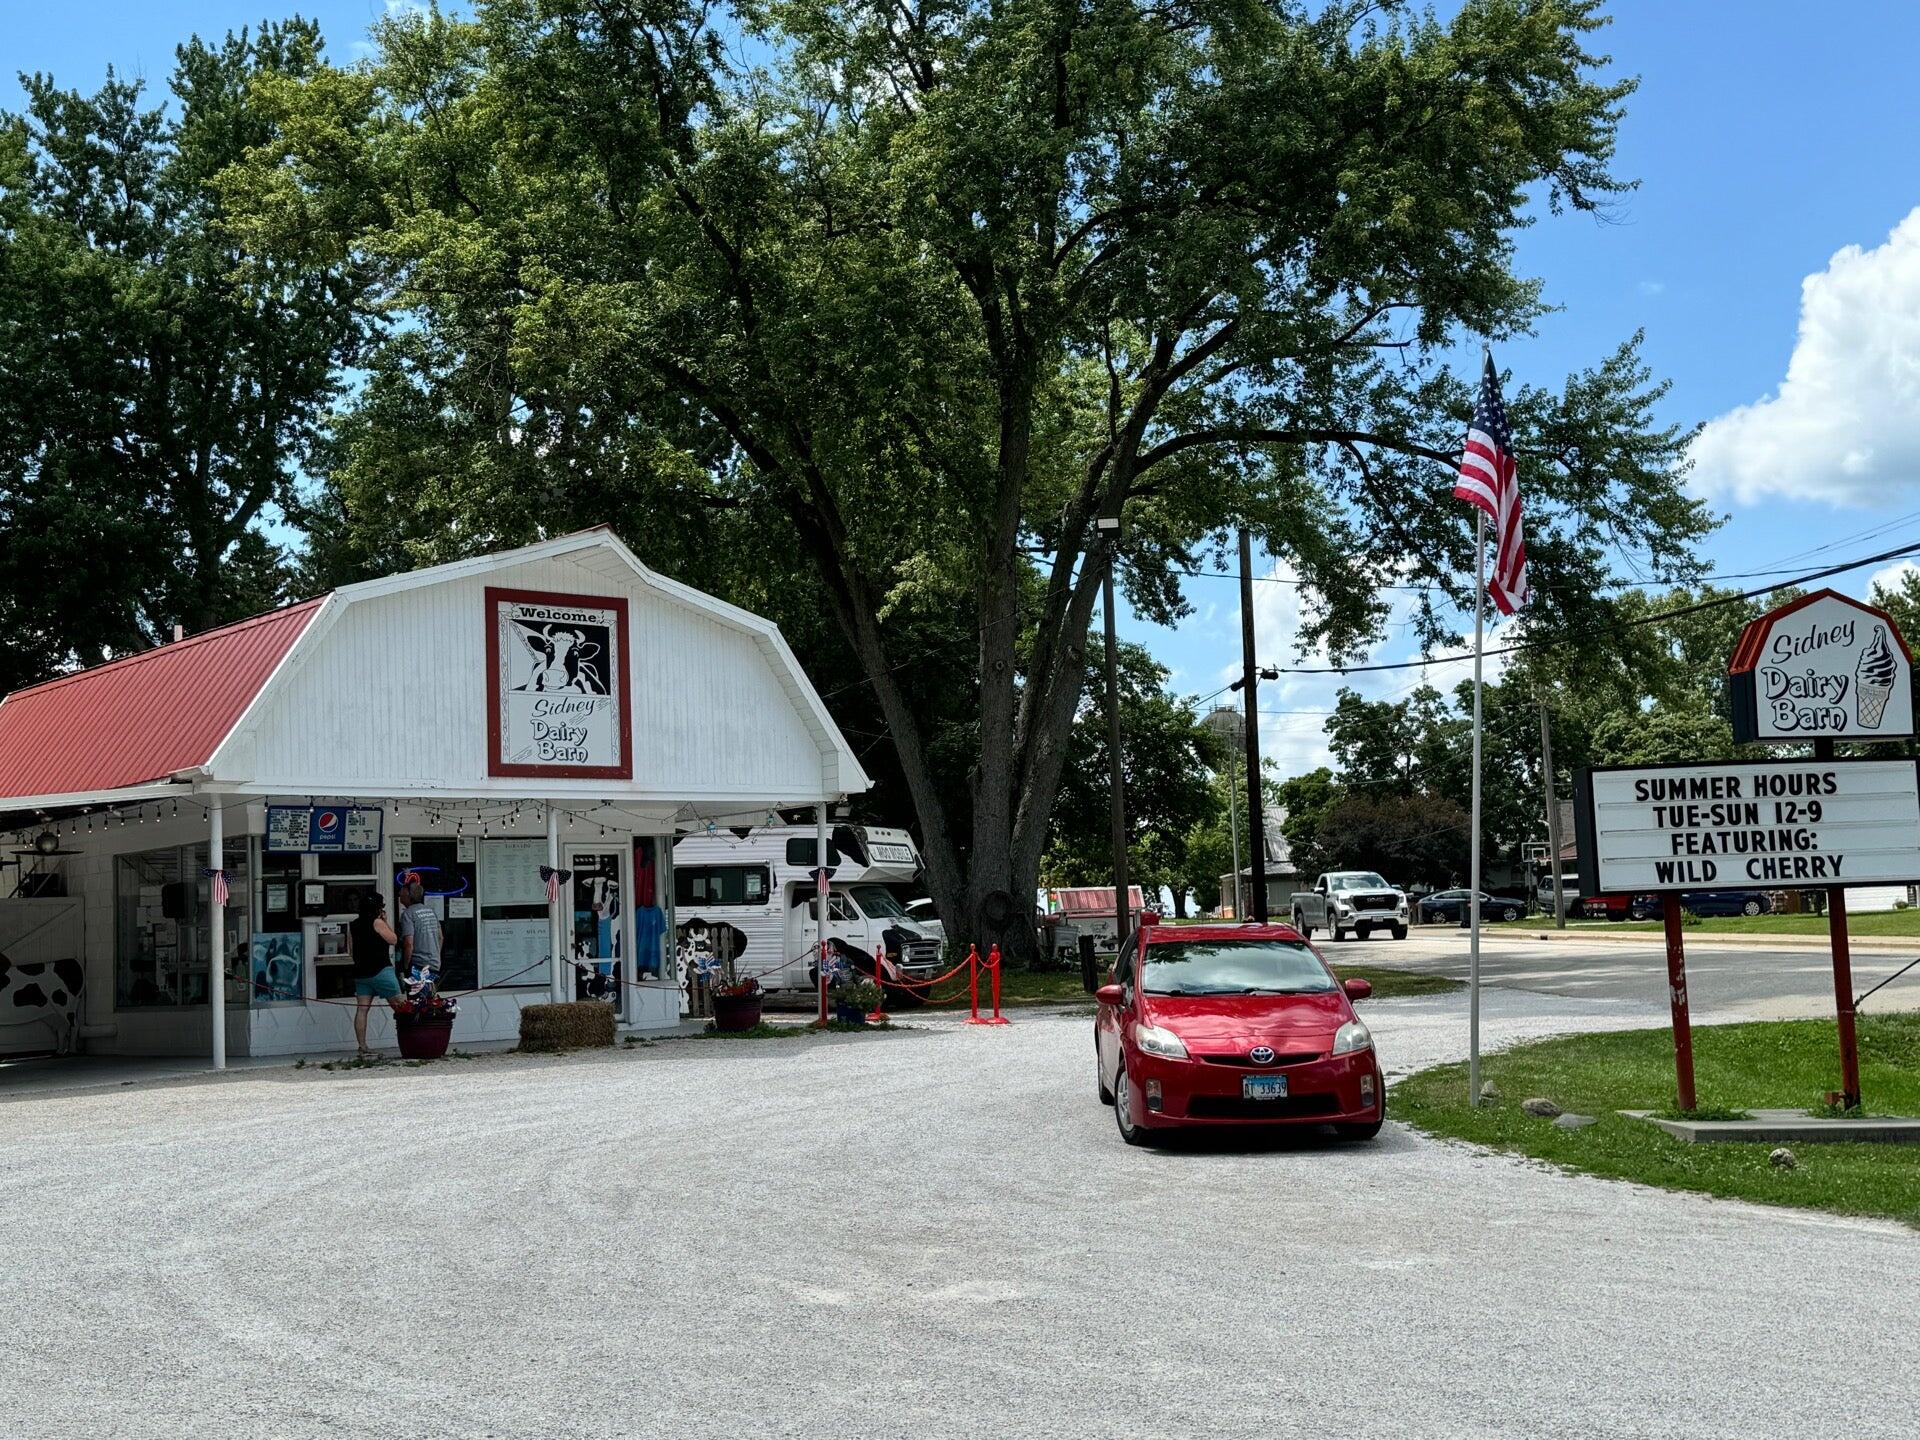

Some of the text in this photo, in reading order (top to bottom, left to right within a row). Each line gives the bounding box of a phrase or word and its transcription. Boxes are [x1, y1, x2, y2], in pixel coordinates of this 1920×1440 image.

[519, 607, 597, 623] Welcome
[1771, 620, 1855, 665] Sidney
[1760, 666, 1850, 704] Dairy
[531, 697, 595, 718] Sidney
[1770, 698, 1848, 732] Barn
[530, 719, 588, 746] Dairy
[537, 740, 589, 763] Barn
[1635, 772, 1837, 802] SUMMER HOURS
[1652, 801, 1823, 828] TUE-SUN 12-9
[319, 833, 336, 841] pepsi
[1671, 829, 1818, 855] FEATURING:
[1655, 855, 1844, 884] WILD CHERRY
[1260, 1082, 1287, 1095] 33639
